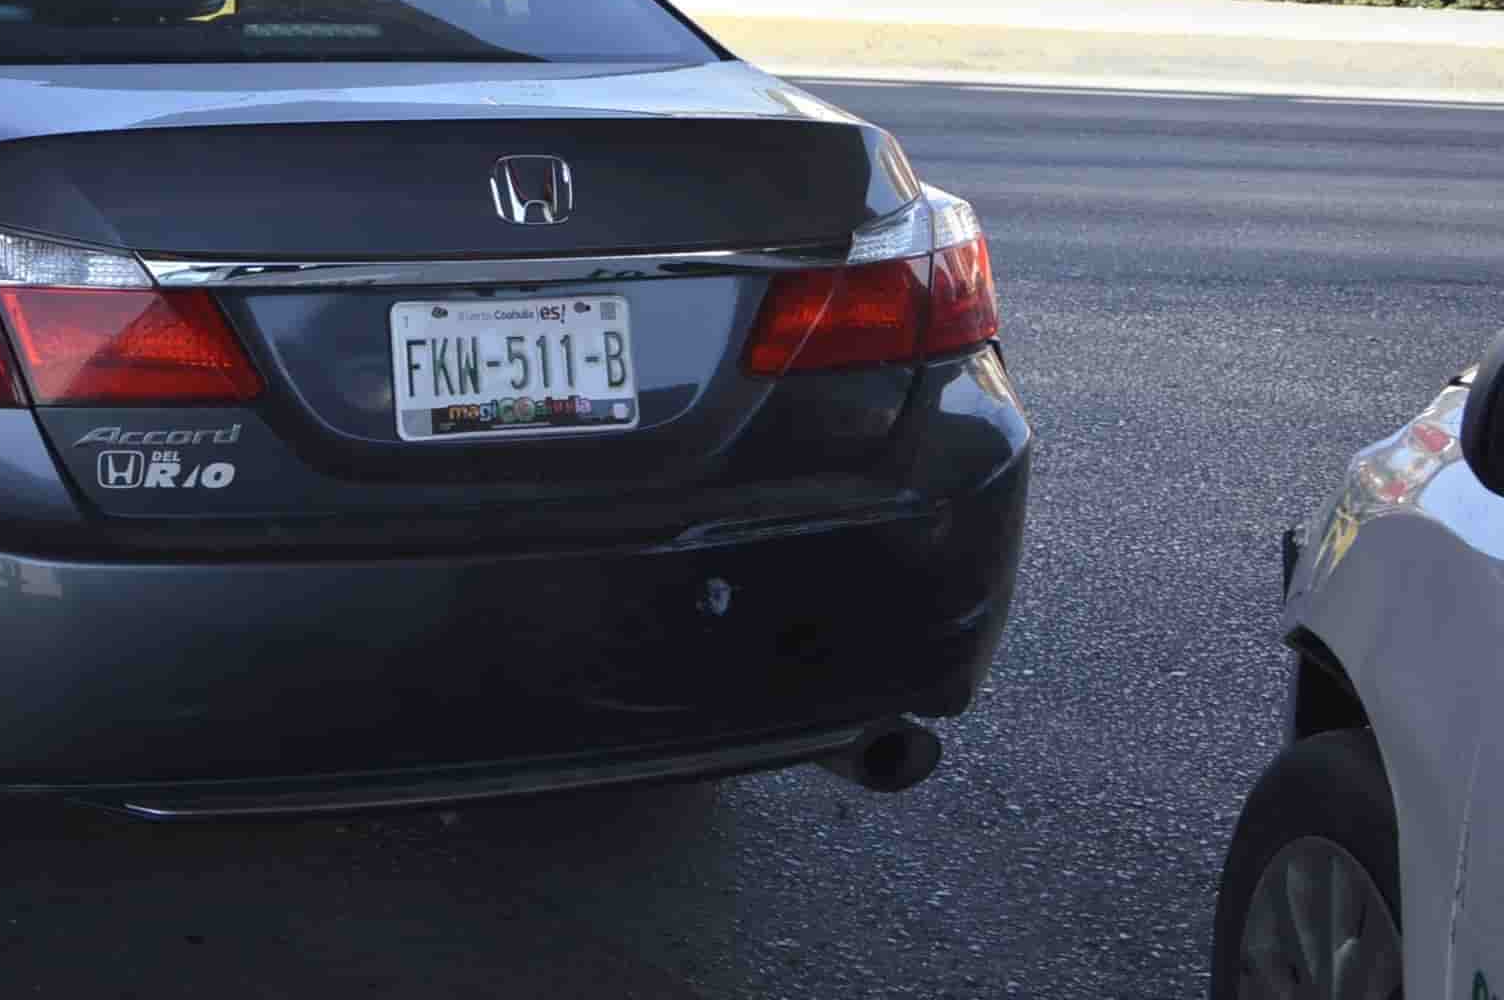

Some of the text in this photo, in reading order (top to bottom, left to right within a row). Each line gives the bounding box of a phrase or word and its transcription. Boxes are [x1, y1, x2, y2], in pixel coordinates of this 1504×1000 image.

[405, 331, 626, 397] FKW-511-B
[72, 424, 242, 448] Accord
[151, 450, 181, 462] DEL
